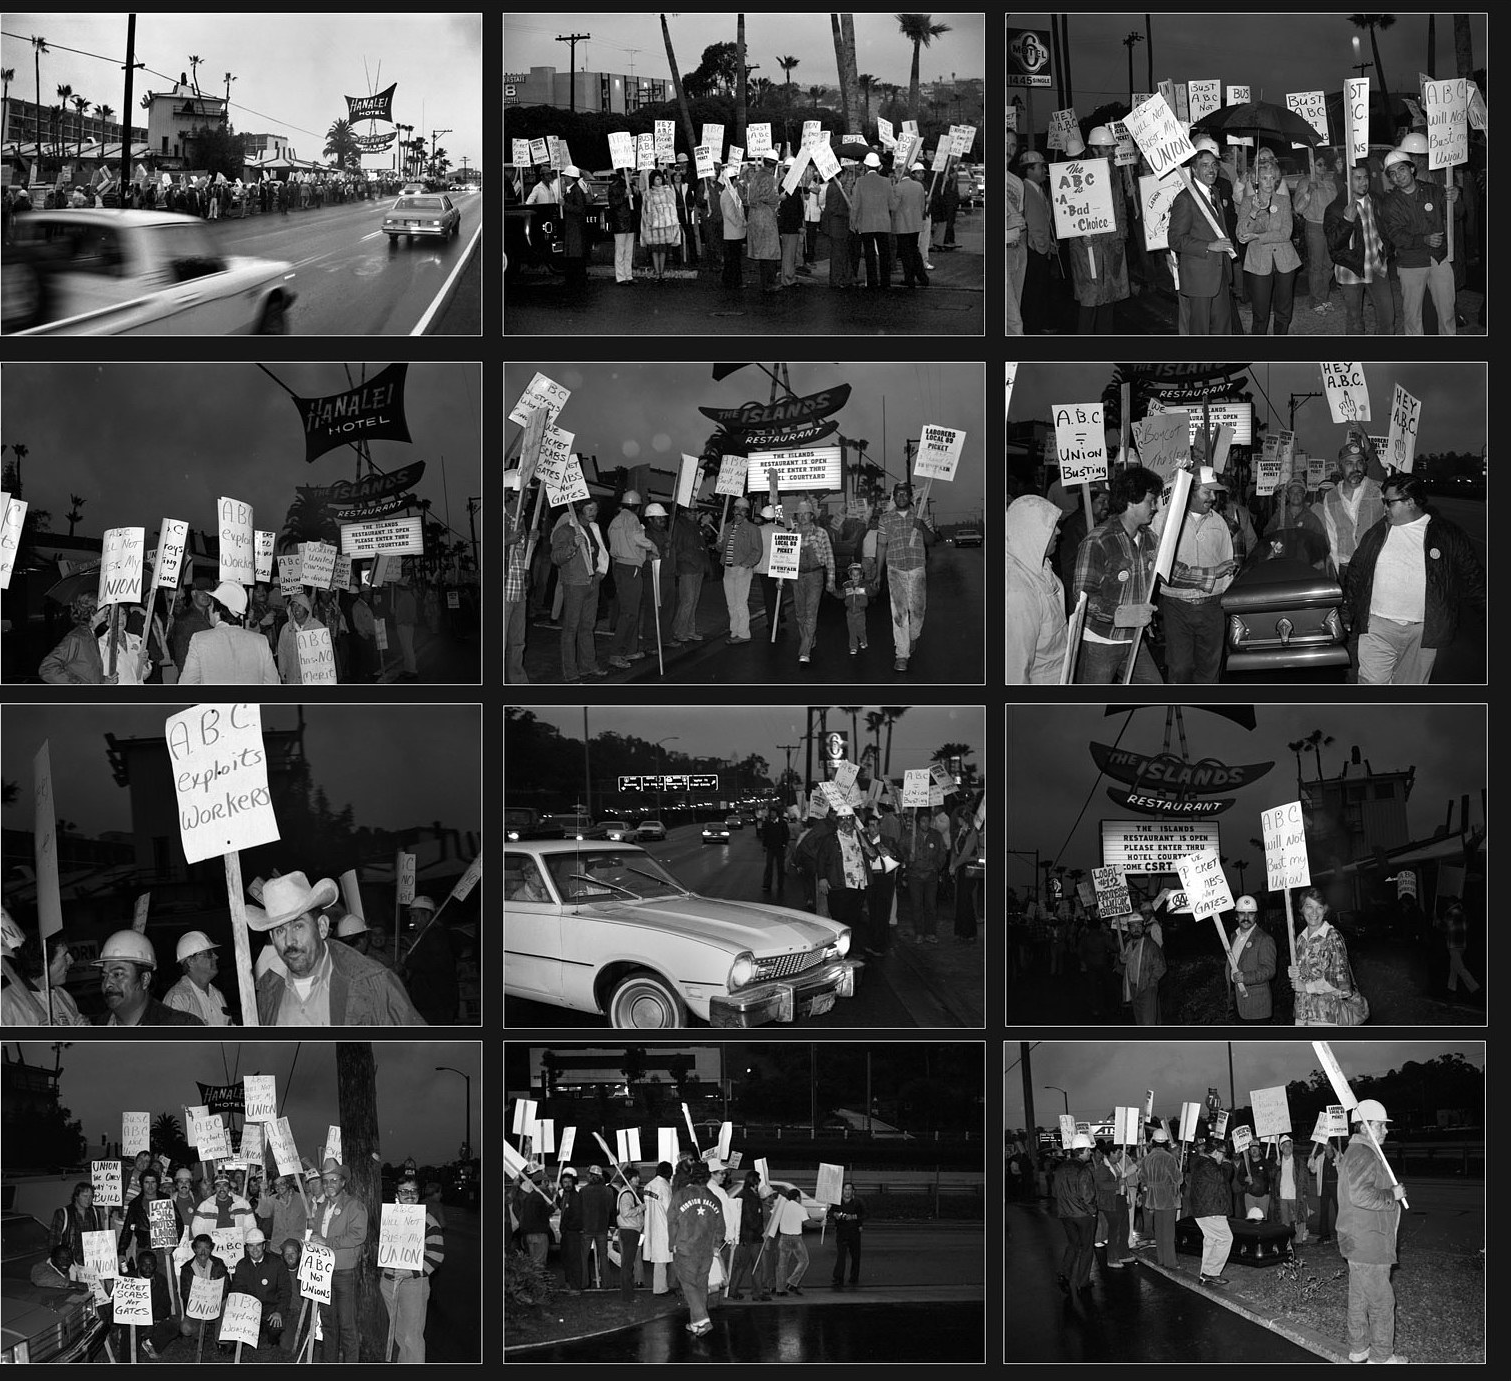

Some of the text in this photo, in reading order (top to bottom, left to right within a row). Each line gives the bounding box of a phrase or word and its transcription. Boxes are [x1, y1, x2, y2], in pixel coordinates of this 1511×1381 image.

[506, 85, 516, 96] 8
[349, 97, 388, 113] HANALEI
[1055, 111, 1073, 121] HEY
[1430, 132, 1454, 148] Bust
[1151, 135, 1189, 171] UNION
[1066, 164, 1083, 174] The
[1059, 173, 1094, 189] ABC
[1069, 205, 1089, 216] Bad
[1078, 217, 1108, 231] Choice
[1323, 363, 1352, 374] HEY
[1327, 373, 1363, 388] A.B.C.
[1160, 384, 1233, 398] RESTAURANT
[307, 384, 393, 432] HANALEI
[742, 394, 831, 422] ISLANDS
[1396, 388, 1417, 413] HEY
[329, 417, 389, 434] HOTEL
[1057, 410, 1101, 427] A.B.C.
[1394, 411, 1416, 436] A.B.C.
[745, 428, 822, 444] RESTAURANT
[925, 428, 956, 439] LABORERS
[928, 443, 948, 451] PICKET
[1060, 449, 1102, 461] UNION
[339, 501, 402, 517] RESTAURANT
[829, 734, 840, 757] 6
[177, 748, 262, 792] exploits
[1110, 753, 1243, 785] THE ISLANDS
[1127, 795, 1223, 811] RESTAURANT
[1145, 862, 1172, 871] CSRT
[1195, 897, 1227, 914] GATES
[247, 1103, 275, 1117] UNION
[94, 1193, 120, 1202] BUILD
[680, 1199, 719, 1214] MISSION VALLEY
[380, 1249, 420, 1264] UNION
[115, 1282, 148, 1290] PICKET
[117, 1290, 149, 1299] SCABS
[115, 1307, 149, 1315] GATES
[187, 1301, 220, 1313] UNION
